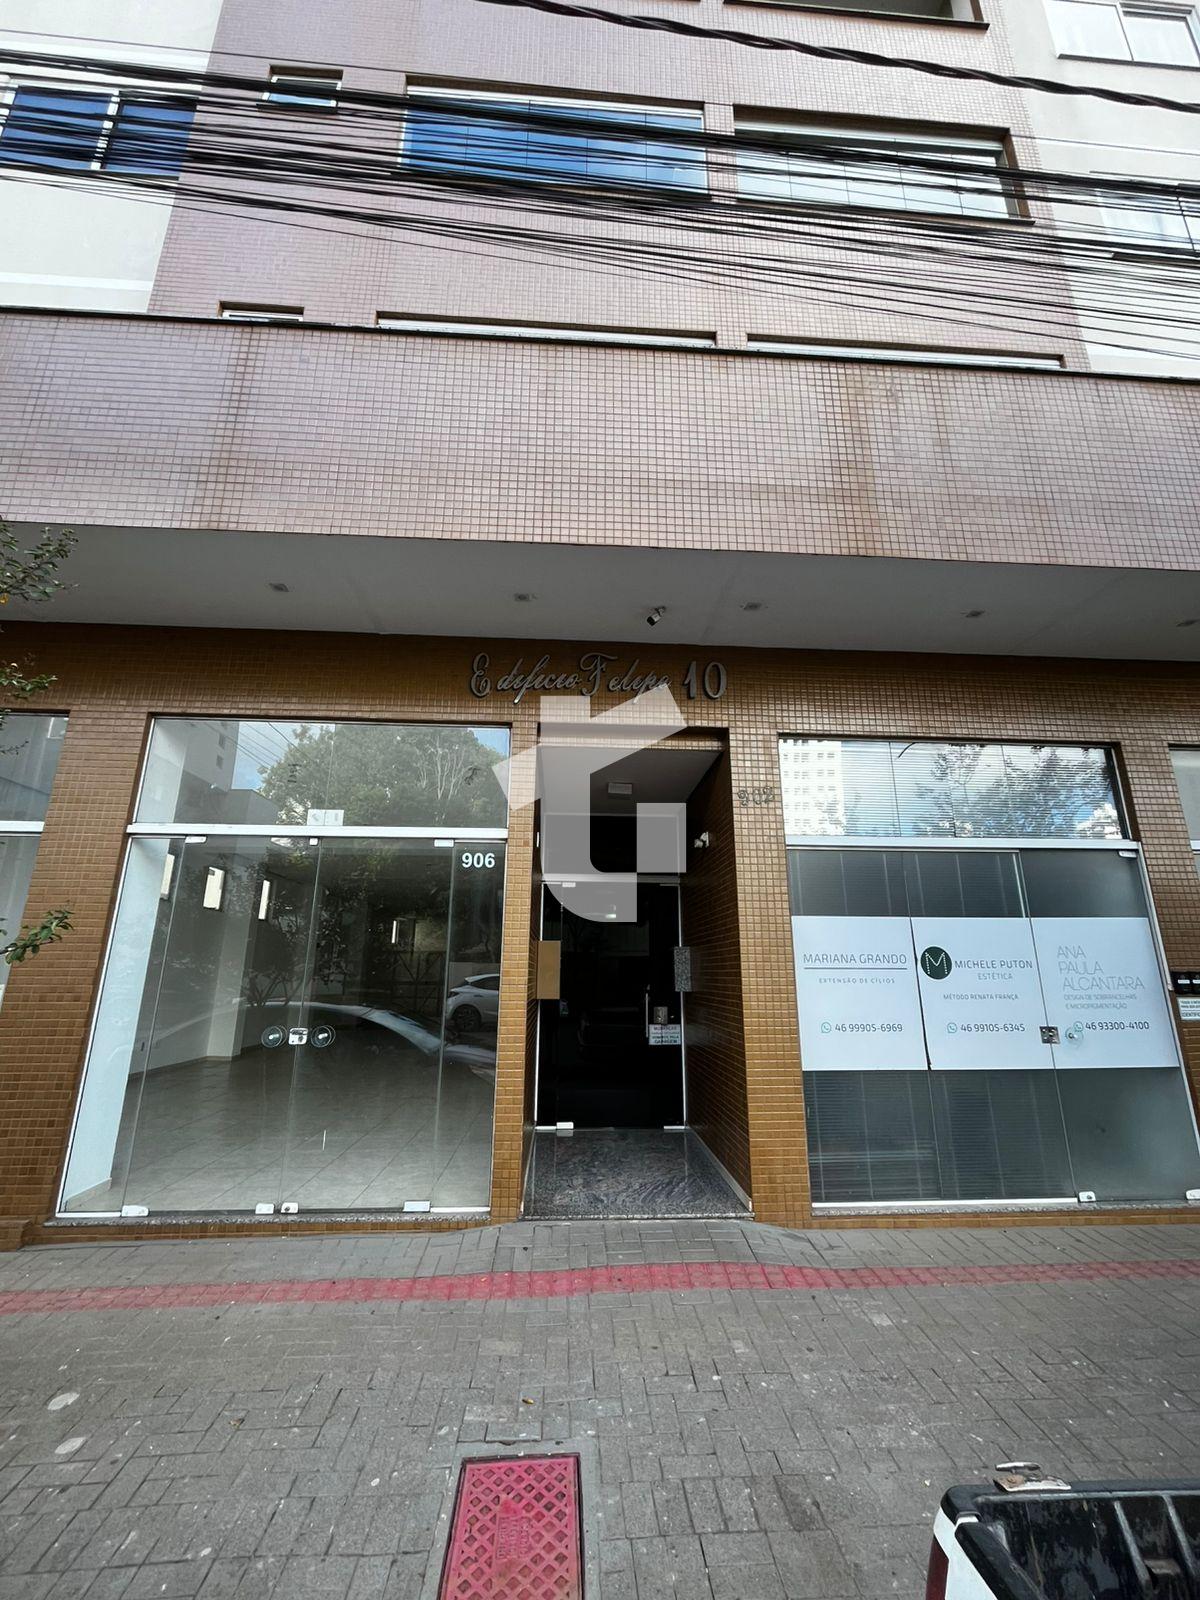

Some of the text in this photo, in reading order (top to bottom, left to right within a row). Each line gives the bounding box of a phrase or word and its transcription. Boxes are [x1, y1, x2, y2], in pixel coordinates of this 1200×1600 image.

[682, 661, 728, 699] 10
[461, 852, 496, 868] 906
[1057, 945, 1087, 959] ANA
[803, 953, 907, 964] MARIANA GRANDO
[954, 959, 1033, 969] MICHELE PUTON
[1058, 961, 1104, 975] PAULA
[977, 972, 1013, 980] ESTÉTICA
[835, 1023, 903, 1032] 46 99905-6969
[960, 1024, 1026, 1032] 46 99105-6345
[1085, 1021, 1150, 1030] 46 93300-4100
